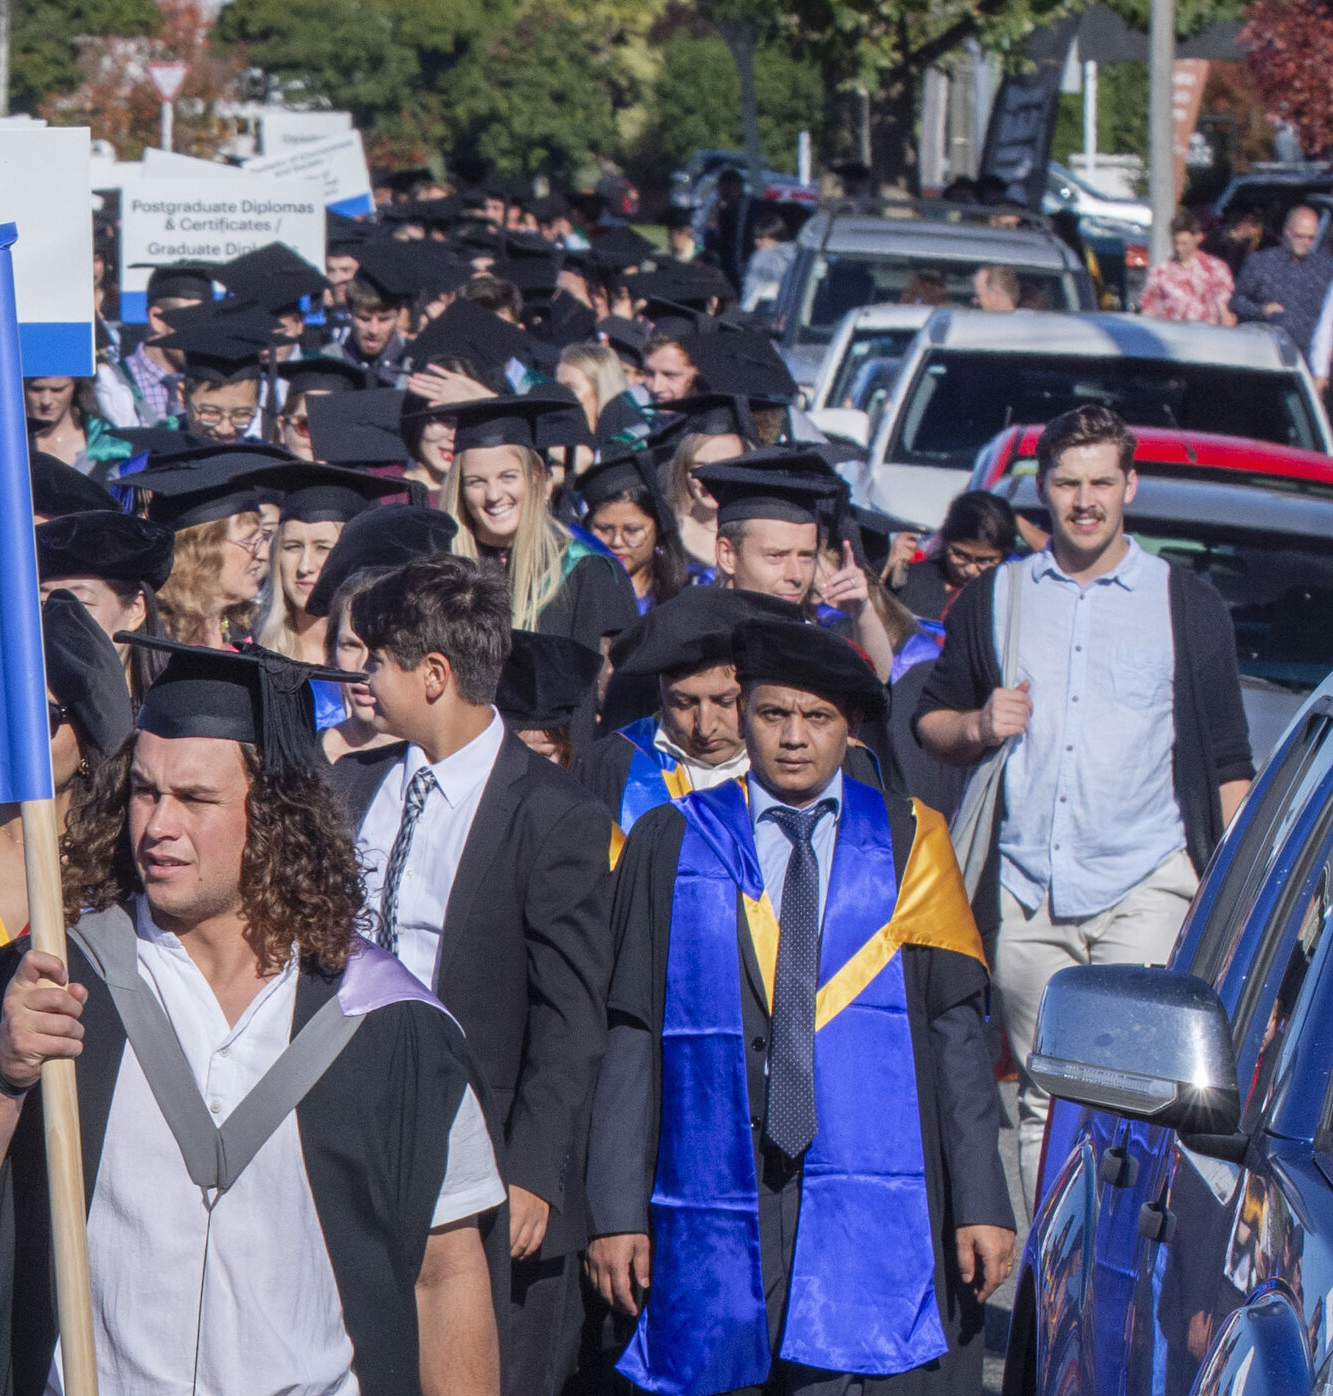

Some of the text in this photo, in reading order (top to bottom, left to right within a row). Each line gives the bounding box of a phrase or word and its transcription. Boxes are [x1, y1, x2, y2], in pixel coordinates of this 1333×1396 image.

[132, 200, 315, 216] Postgraduate Diplomas
[165, 219, 175, 232] &
[180, 217, 272, 233] Certificates
[148, 242, 221, 257] Graduate
